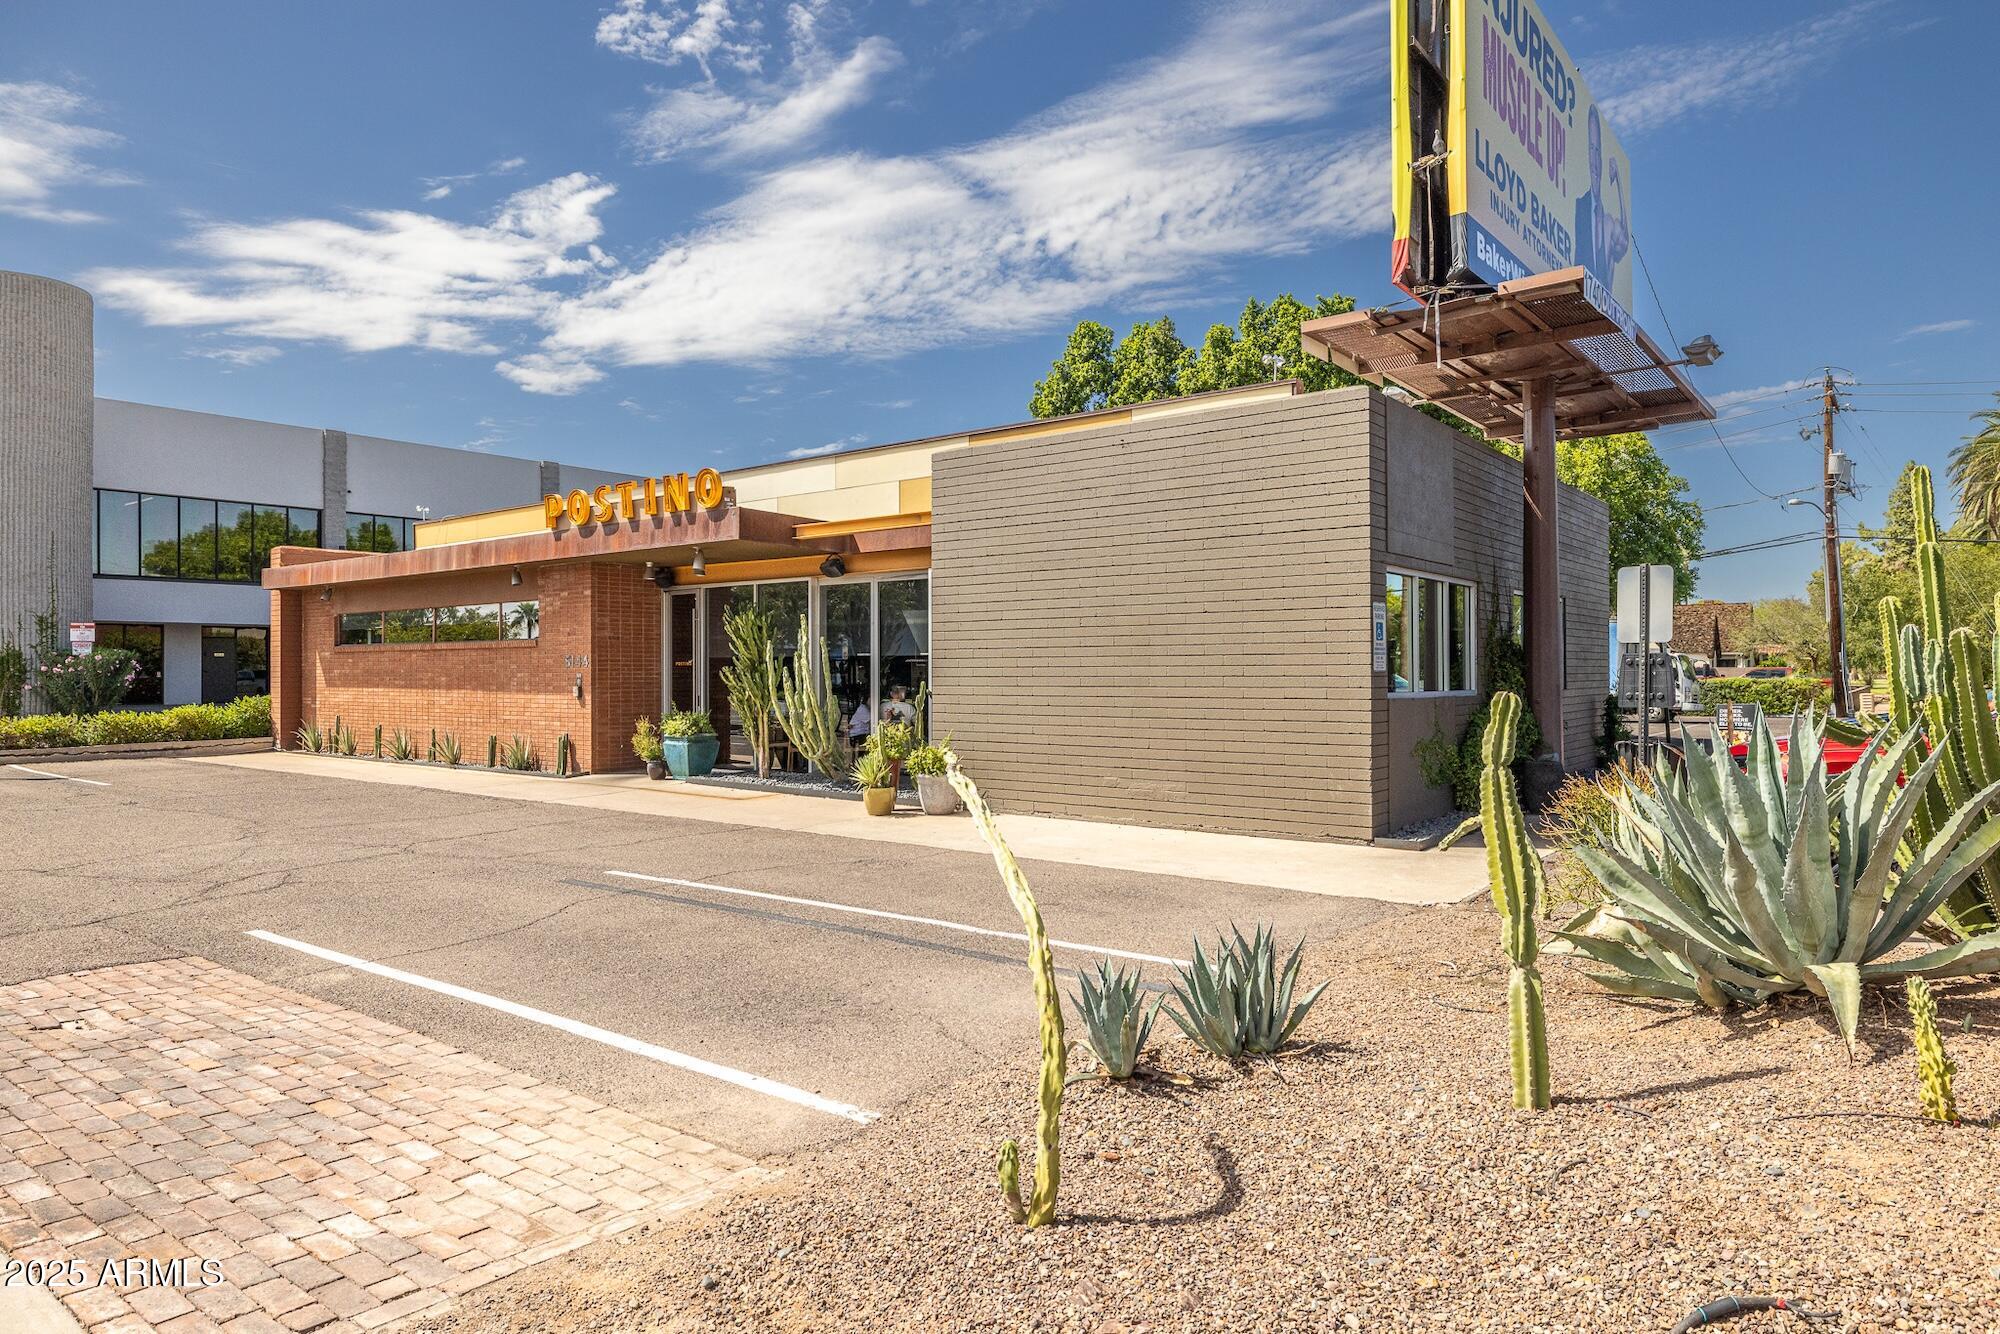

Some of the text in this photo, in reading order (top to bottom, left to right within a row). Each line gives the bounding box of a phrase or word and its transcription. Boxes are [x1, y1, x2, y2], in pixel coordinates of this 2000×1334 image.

[1482, 14, 1566, 198] MUSCLE UP!
[1484, 0, 1576, 129] JURED?
[1475, 128, 1572, 265] LLOYD BAKER
[1490, 189, 1519, 235] INJURY
[544, 467, 723, 529] POSTINO
